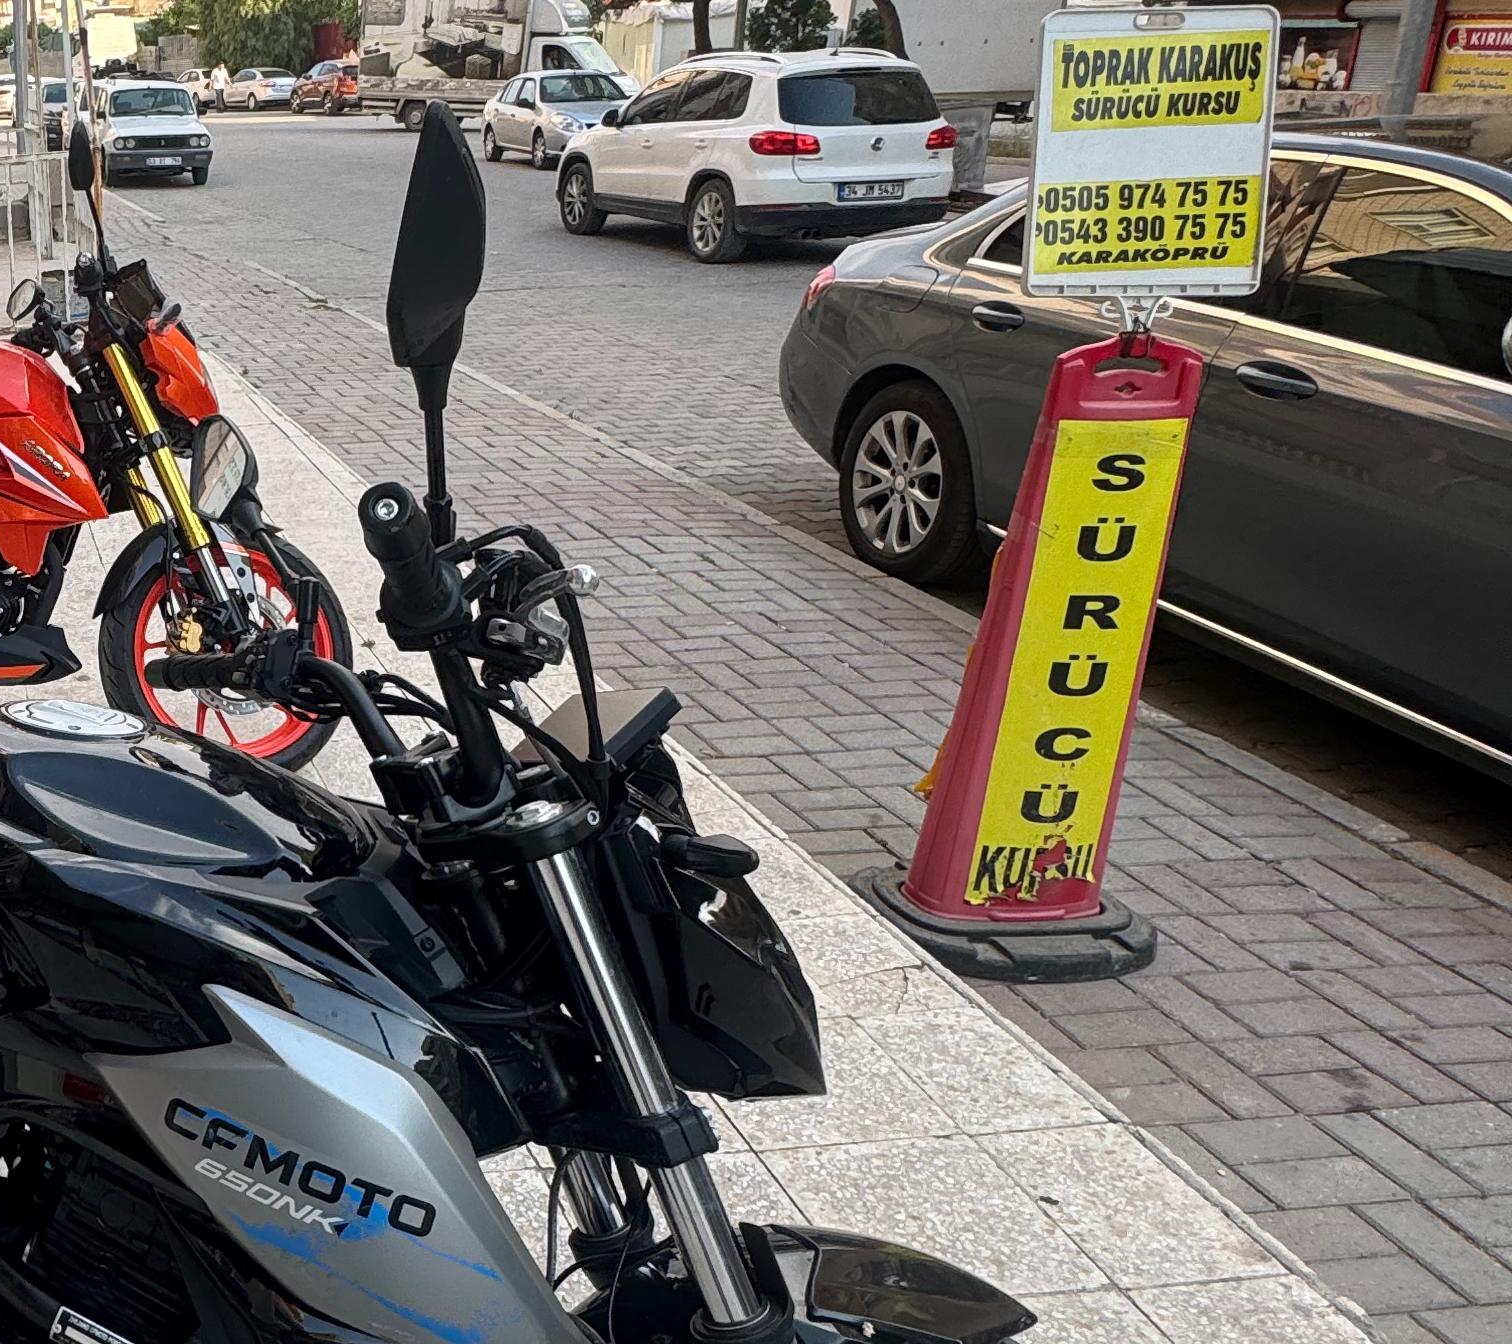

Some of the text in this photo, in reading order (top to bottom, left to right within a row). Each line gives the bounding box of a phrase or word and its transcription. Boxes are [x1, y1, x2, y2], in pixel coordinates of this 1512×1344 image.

[1061, 41, 1262, 91] TOPRAK KARAKUŞ
[1071, 87, 1240, 122] SÜRÜCÜ KURSU
[846, 185, 858, 197] 34
[1044, 179, 1248, 214] 0505 974 75 75
[1042, 212, 1246, 246] 0543 390 75 75
[1056, 241, 1230, 266] KARAKÖPRÜ
[973, 843, 1094, 893] KUU
[164, 1097, 437, 1238] CFMOTO
[193, 1157, 346, 1236] 650NK
